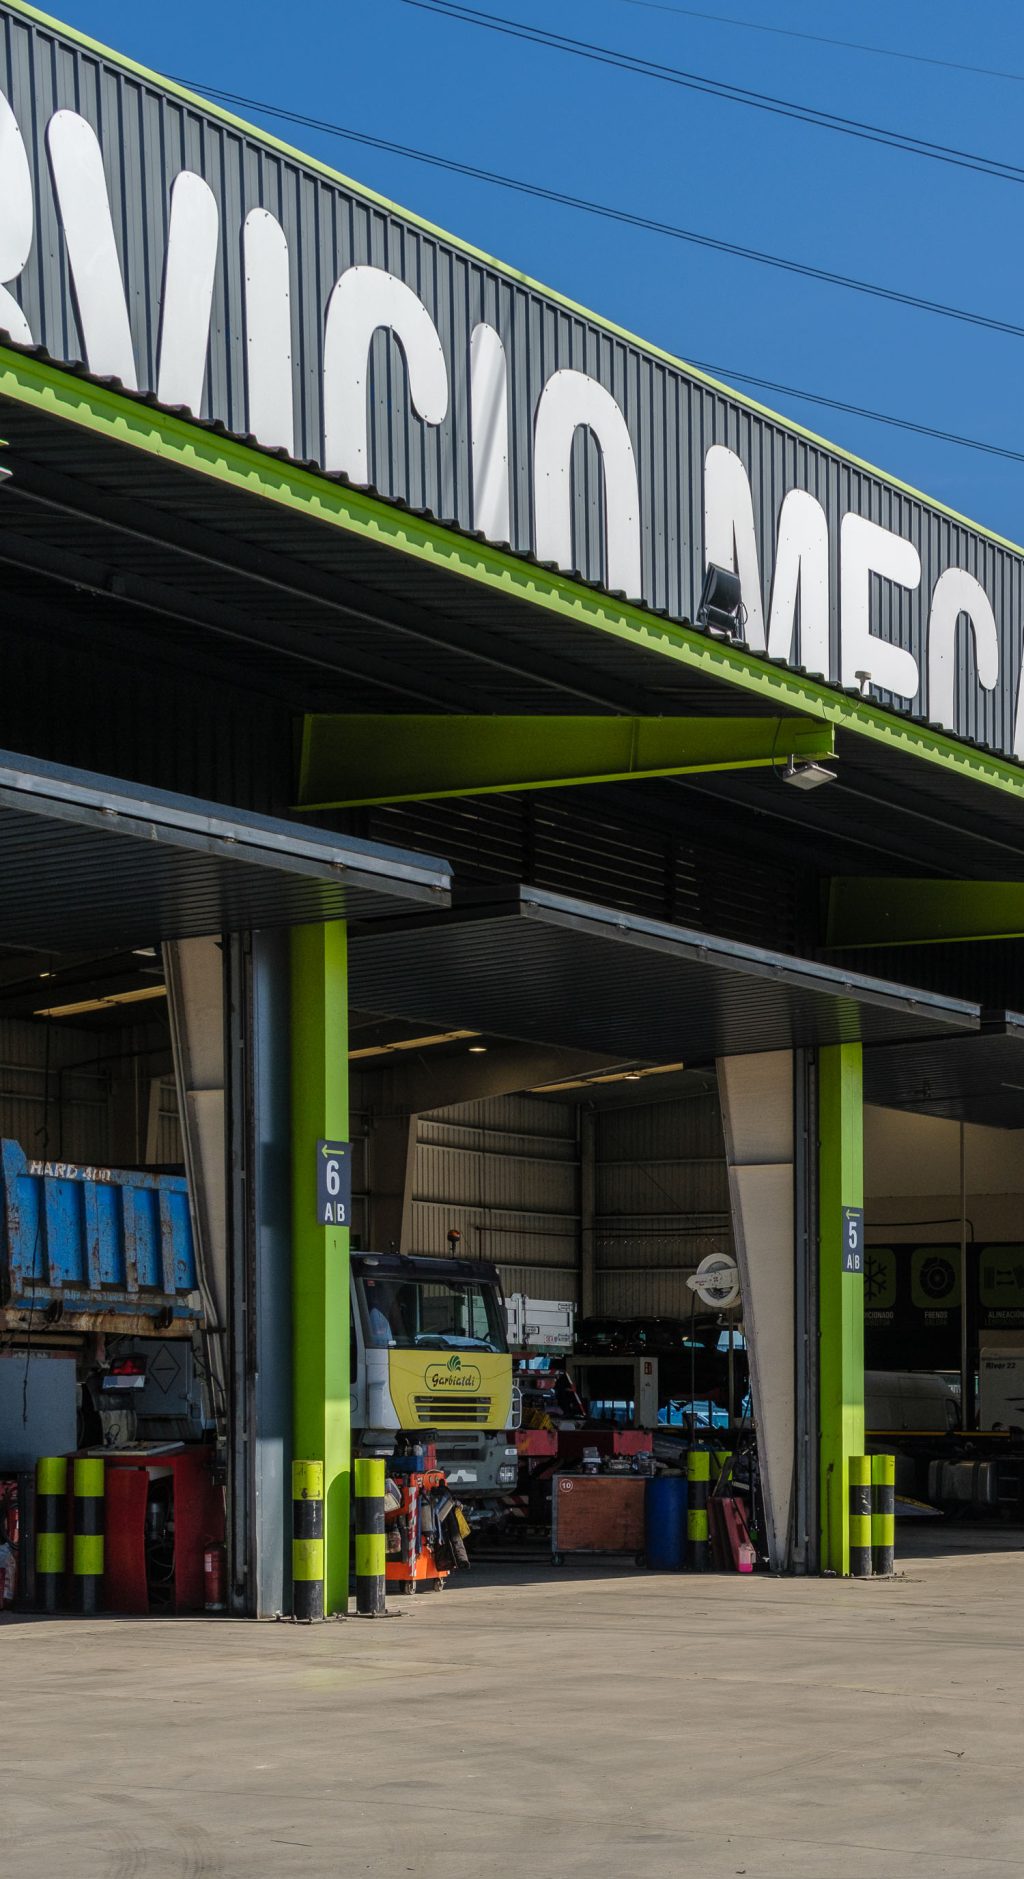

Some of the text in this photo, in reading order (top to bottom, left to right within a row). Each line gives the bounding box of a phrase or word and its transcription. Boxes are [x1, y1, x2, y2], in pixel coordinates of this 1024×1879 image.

[29, 1159, 79, 1179] HARD
[325, 1159, 341, 1196] 6
[848, 1221, 858, 1249] 5
